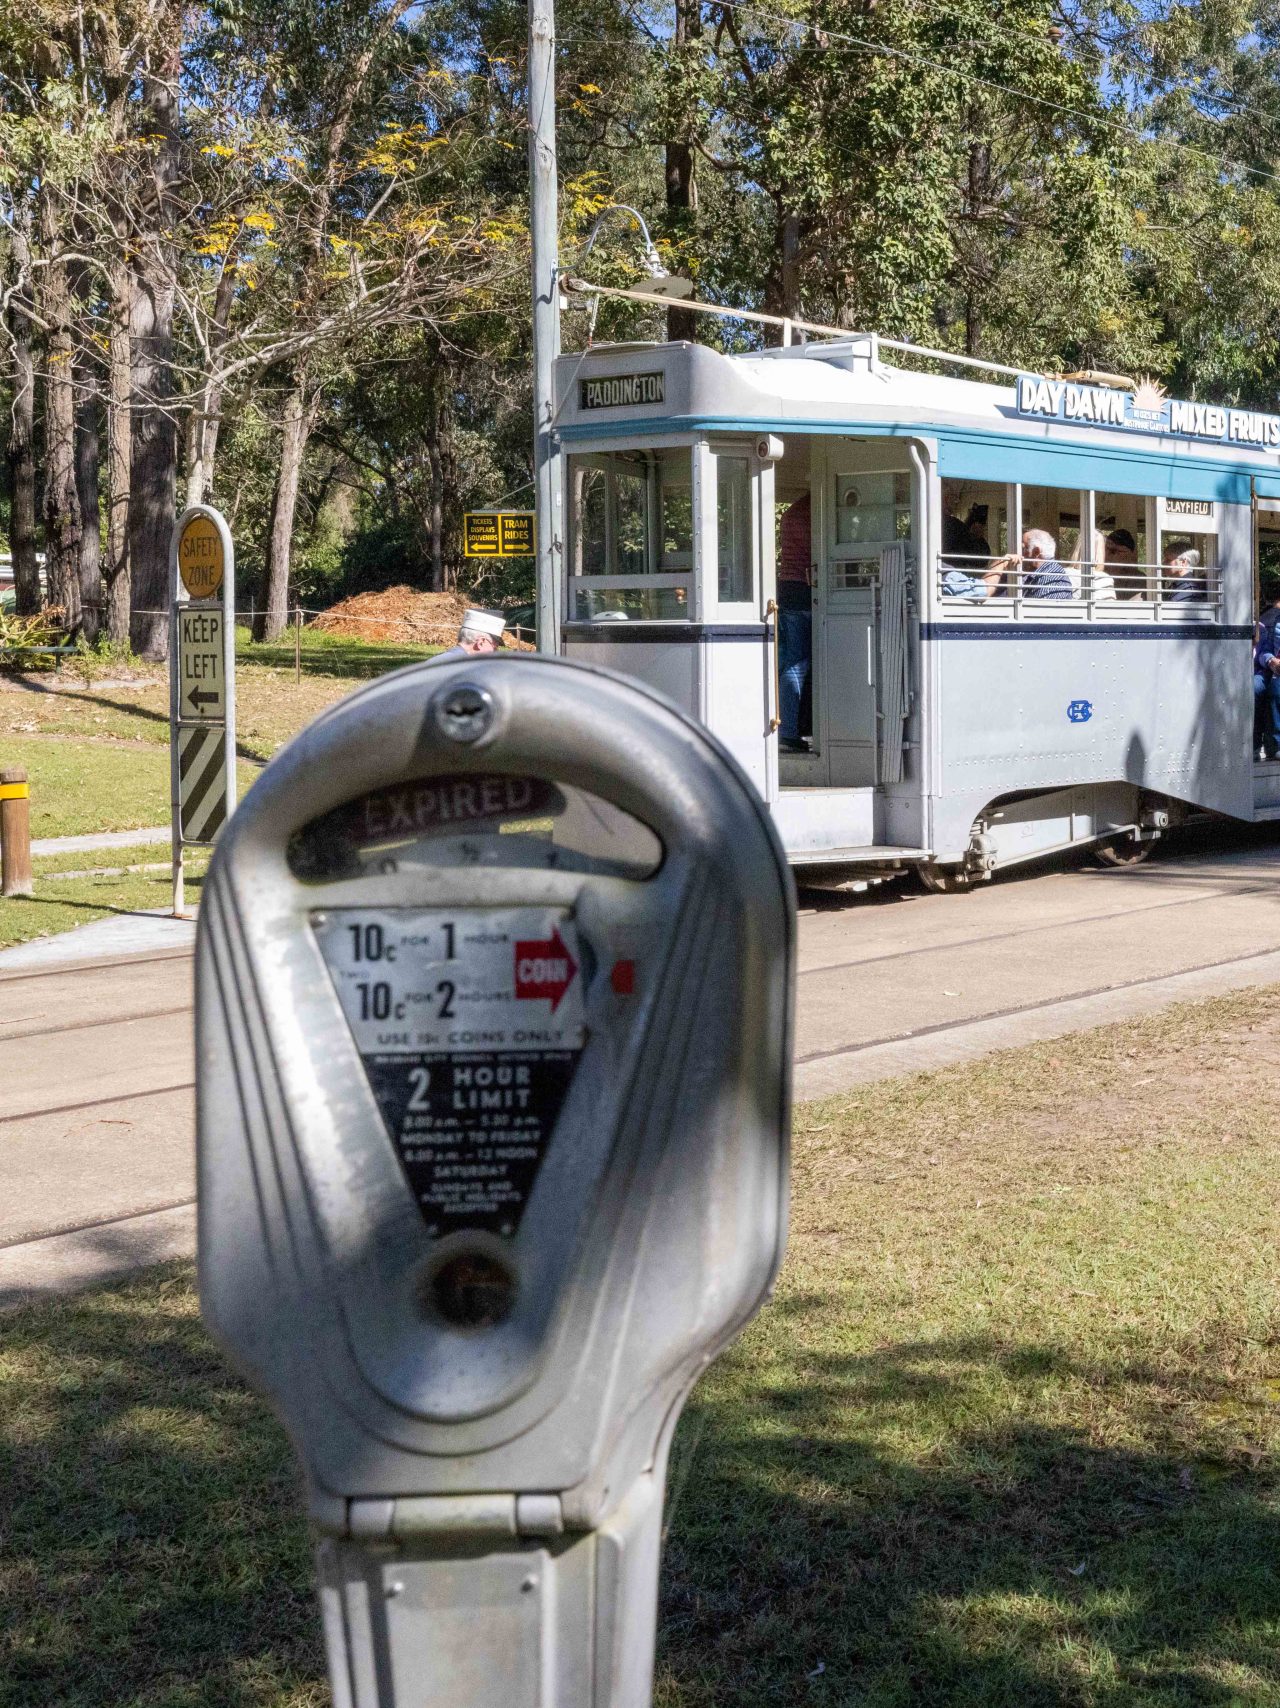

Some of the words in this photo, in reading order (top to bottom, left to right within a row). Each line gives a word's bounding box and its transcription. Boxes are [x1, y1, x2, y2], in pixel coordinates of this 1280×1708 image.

[587, 375, 664, 407] PADDINGTON
[1021, 377, 1065, 417] DAY
[1064, 385, 1125, 426] DAWN
[1170, 401, 1227, 438] MIXED
[1229, 410, 1280, 446] FRUITS
[1166, 501, 1208, 515] CLAYFIELD
[504, 519, 528, 529] TRAM
[504, 530, 529, 540] RIDES
[183, 536, 218, 558] SAFETY
[188, 565, 215, 587] ZONE
[184, 618, 219, 643] KEEP
[185, 654, 218, 679] LEFT
[364, 778, 532, 836] EXPIRED
[348, 923, 397, 963] 10c
[401, 936, 430, 946] FOR
[441, 923, 455, 960] 1
[519, 958, 568, 984] COIN
[356, 981, 405, 1021] 10c
[437, 980, 456, 1019] 2
[377, 1032, 409, 1045] USE
[449, 1031, 504, 1044] COINS
[513, 1030, 563, 1043] ONLY
[407, 1067, 431, 1111] 2
[453, 1065, 531, 1086] HOUR
[453, 1089, 531, 1110] LIMIT
[400, 1132, 463, 1145] MONDAY
[490, 1130, 541, 1142] FRIDAY
[433, 1164, 509, 1178] SATURDAY
